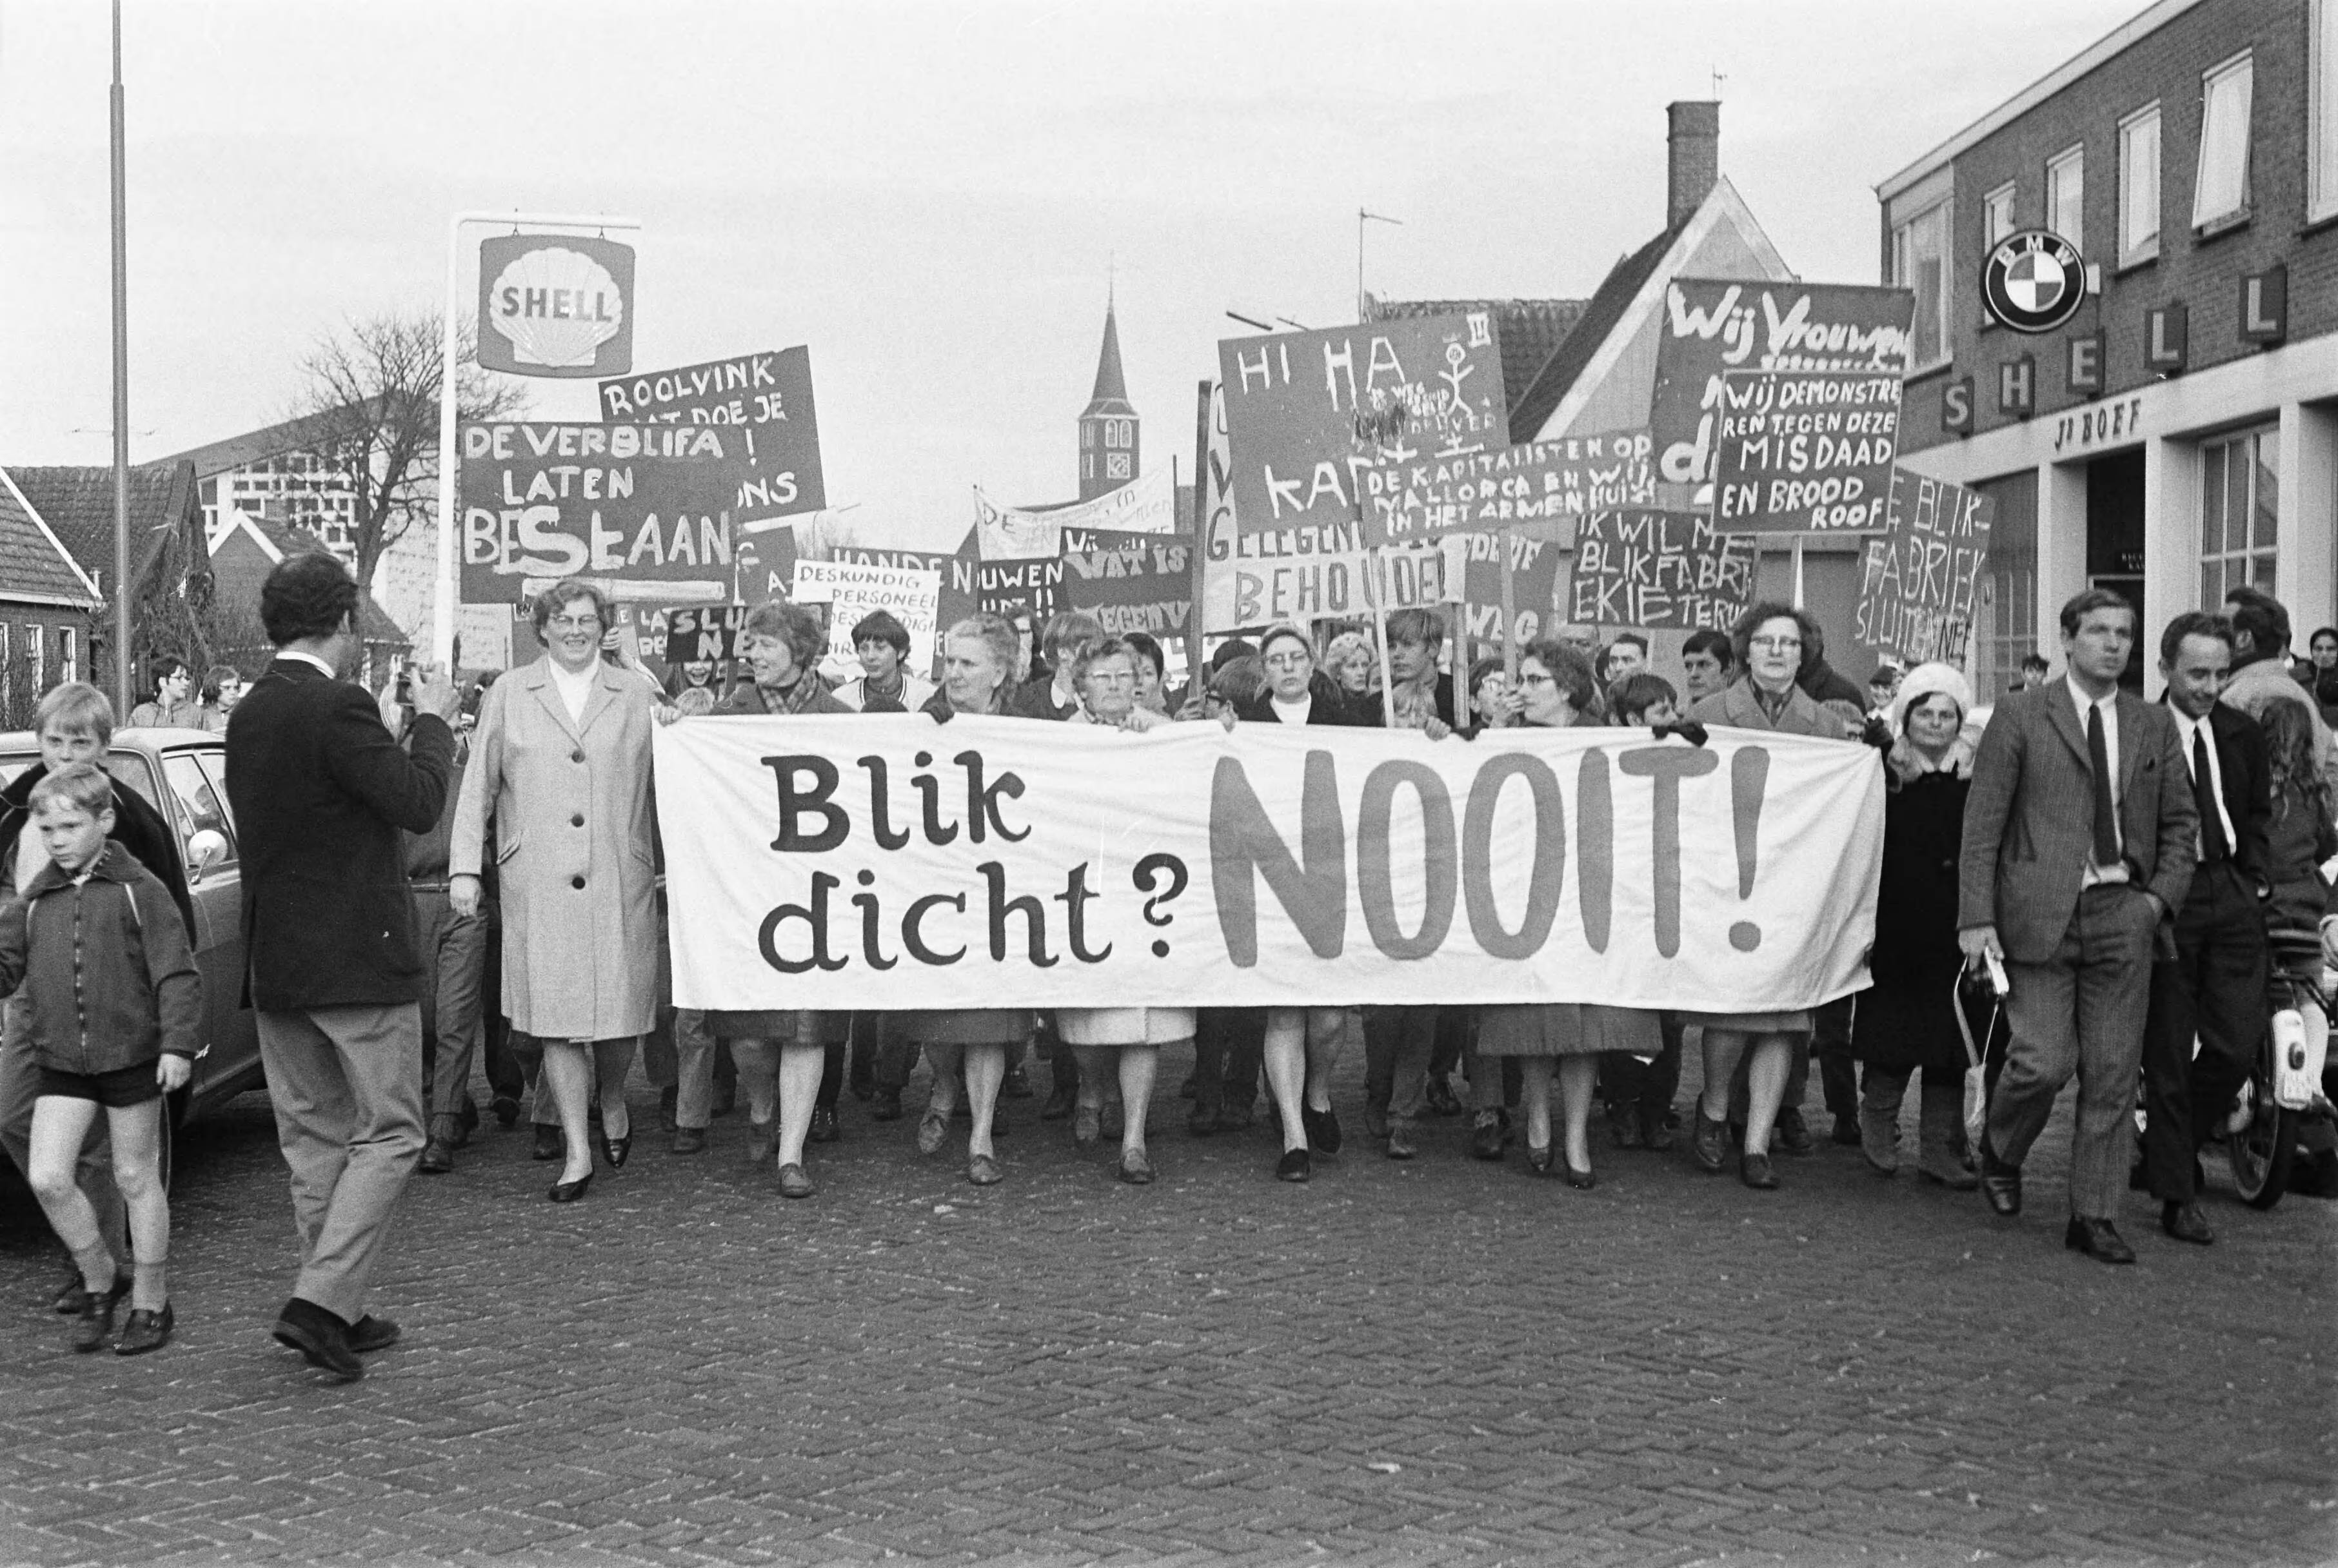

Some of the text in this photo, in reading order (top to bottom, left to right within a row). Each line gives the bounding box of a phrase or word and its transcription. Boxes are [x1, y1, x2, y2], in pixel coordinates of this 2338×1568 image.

[1996, 233, 2075, 267] BMW
[502, 286, 613, 322] SHELL
[1667, 283, 1756, 365] Wij
[1946, 278, 2277, 426] SHELL
[604, 355, 775, 416] ROOLVINK
[1237, 341, 1290, 395] HI
[1323, 335, 1405, 413] HA
[1727, 373, 1901, 414] Wij DEMONSTRE
[754, 392, 788, 423] JE
[1722, 412, 1897, 438] REN TEGEN DEZE
[2081, 398, 2141, 444] BOEF
[466, 425, 724, 460] DE VERBLIFA
[503, 465, 633, 505] LATEN
[1368, 470, 1402, 495] DE
[1613, 434, 1652, 461] OP
[1374, 474, 1531, 513] MALLORCA
[1544, 470, 1579, 493] EN
[1721, 481, 1759, 517] EN
[1768, 477, 1864, 513] BROOD
[1386, 510, 1412, 537] IN
[1424, 503, 1472, 530] HET
[1580, 511, 1609, 539] IK
[1616, 511, 1683, 555] WIL
[1811, 498, 1883, 530] ROOF
[800, 566, 920, 589] DESKUNDIG
[976, 558, 1064, 590] UWEN
[1862, 535, 1986, 614] FABRIEK
[1574, 575, 1673, 626] EKIE
[760, 749, 1032, 853] Blik
